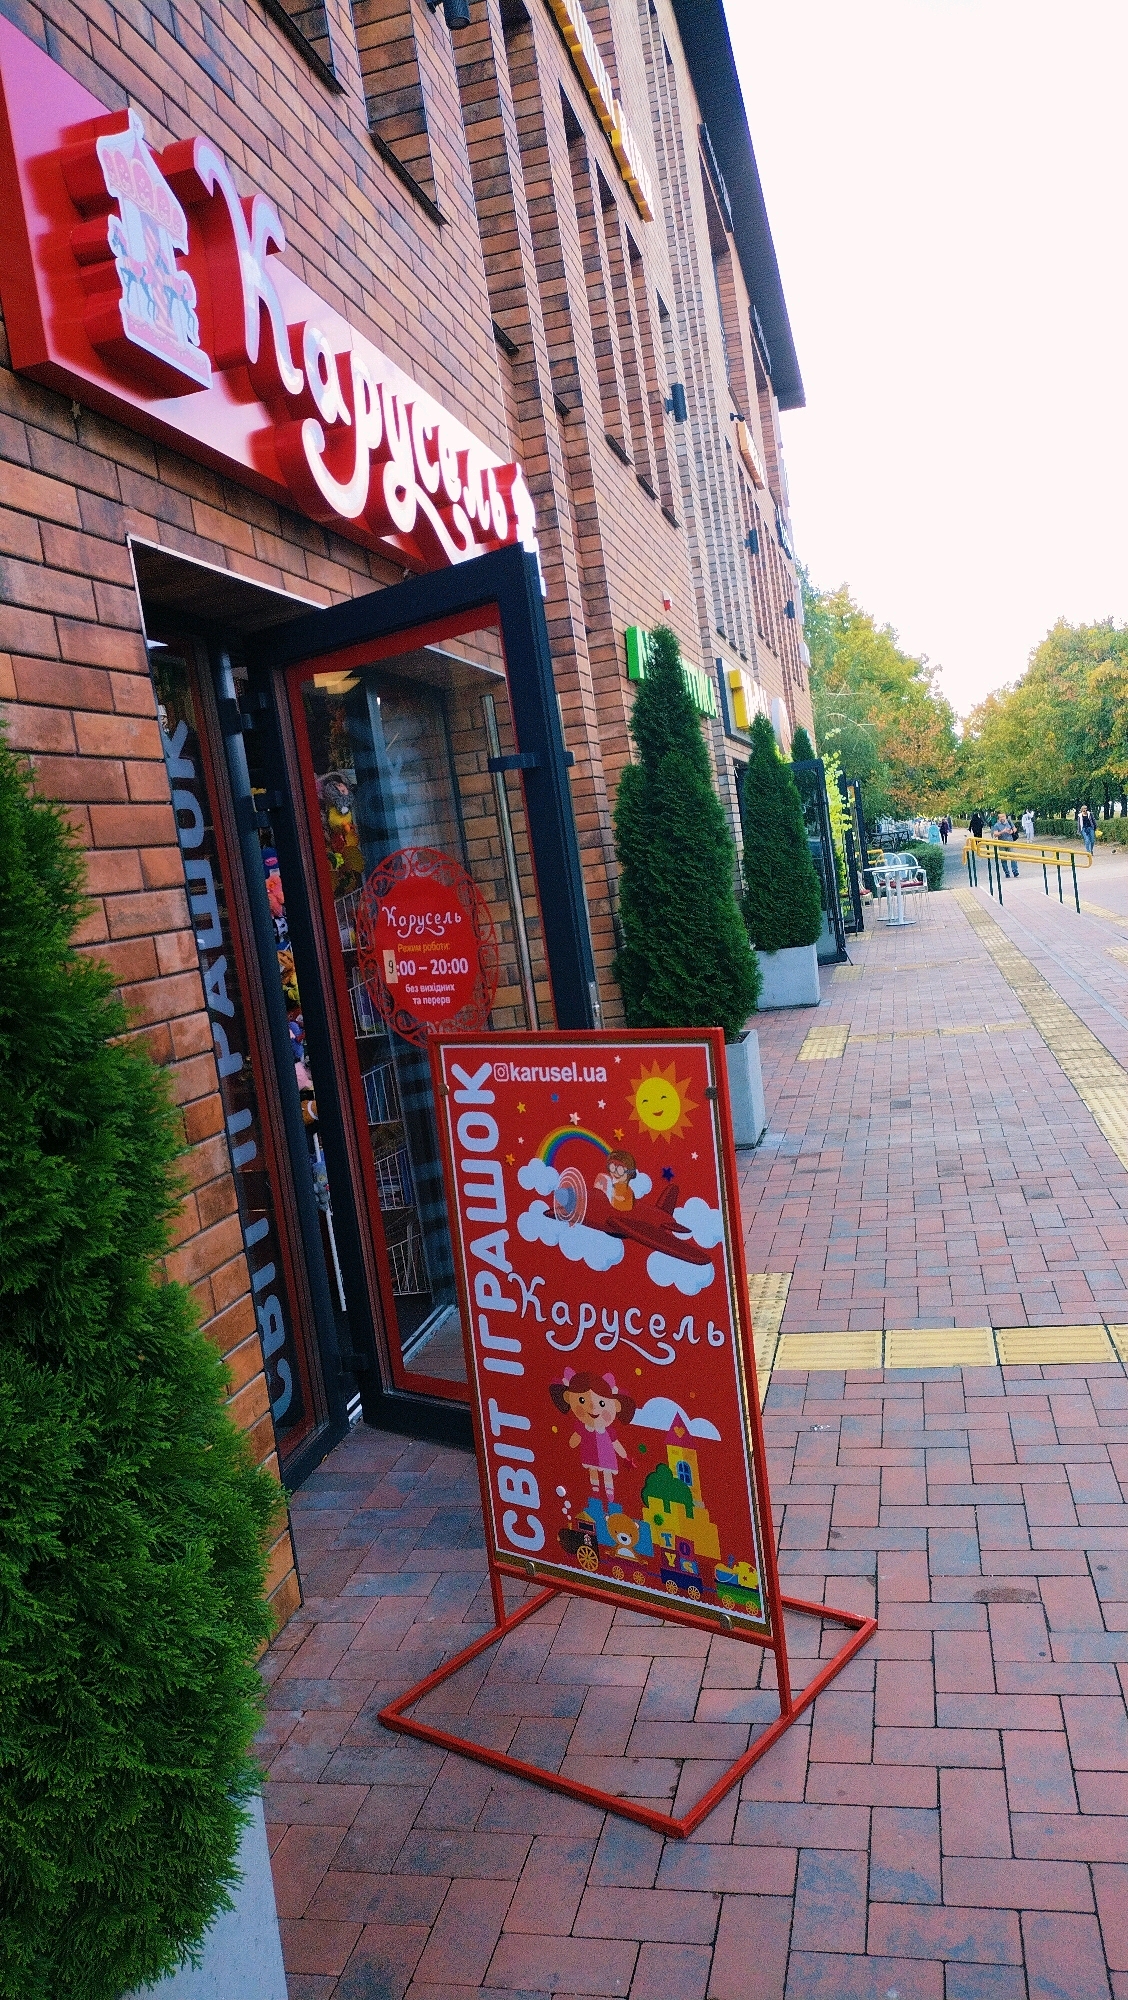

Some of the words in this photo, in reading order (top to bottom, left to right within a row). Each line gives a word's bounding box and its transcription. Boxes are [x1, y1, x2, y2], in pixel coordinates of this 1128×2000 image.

[193, 135, 508, 565] Карусель
[382, 906, 461, 938] Карусель
[398, 943, 421, 953] Режим
[430, 957, 469, 975] 20:00
[405, 983, 419, 993] без
[420, 982, 455, 993] вихідних
[412, 997, 421, 1005] та
[423, 996, 451, 1006] перерв
[510, 1062, 607, 1083] karusel.ua
[451, 1062, 525, 1377] ІГРАШОК
[508, 1272, 725, 1365] Карусель
[488, 1397, 545, 1552] СВІТ
